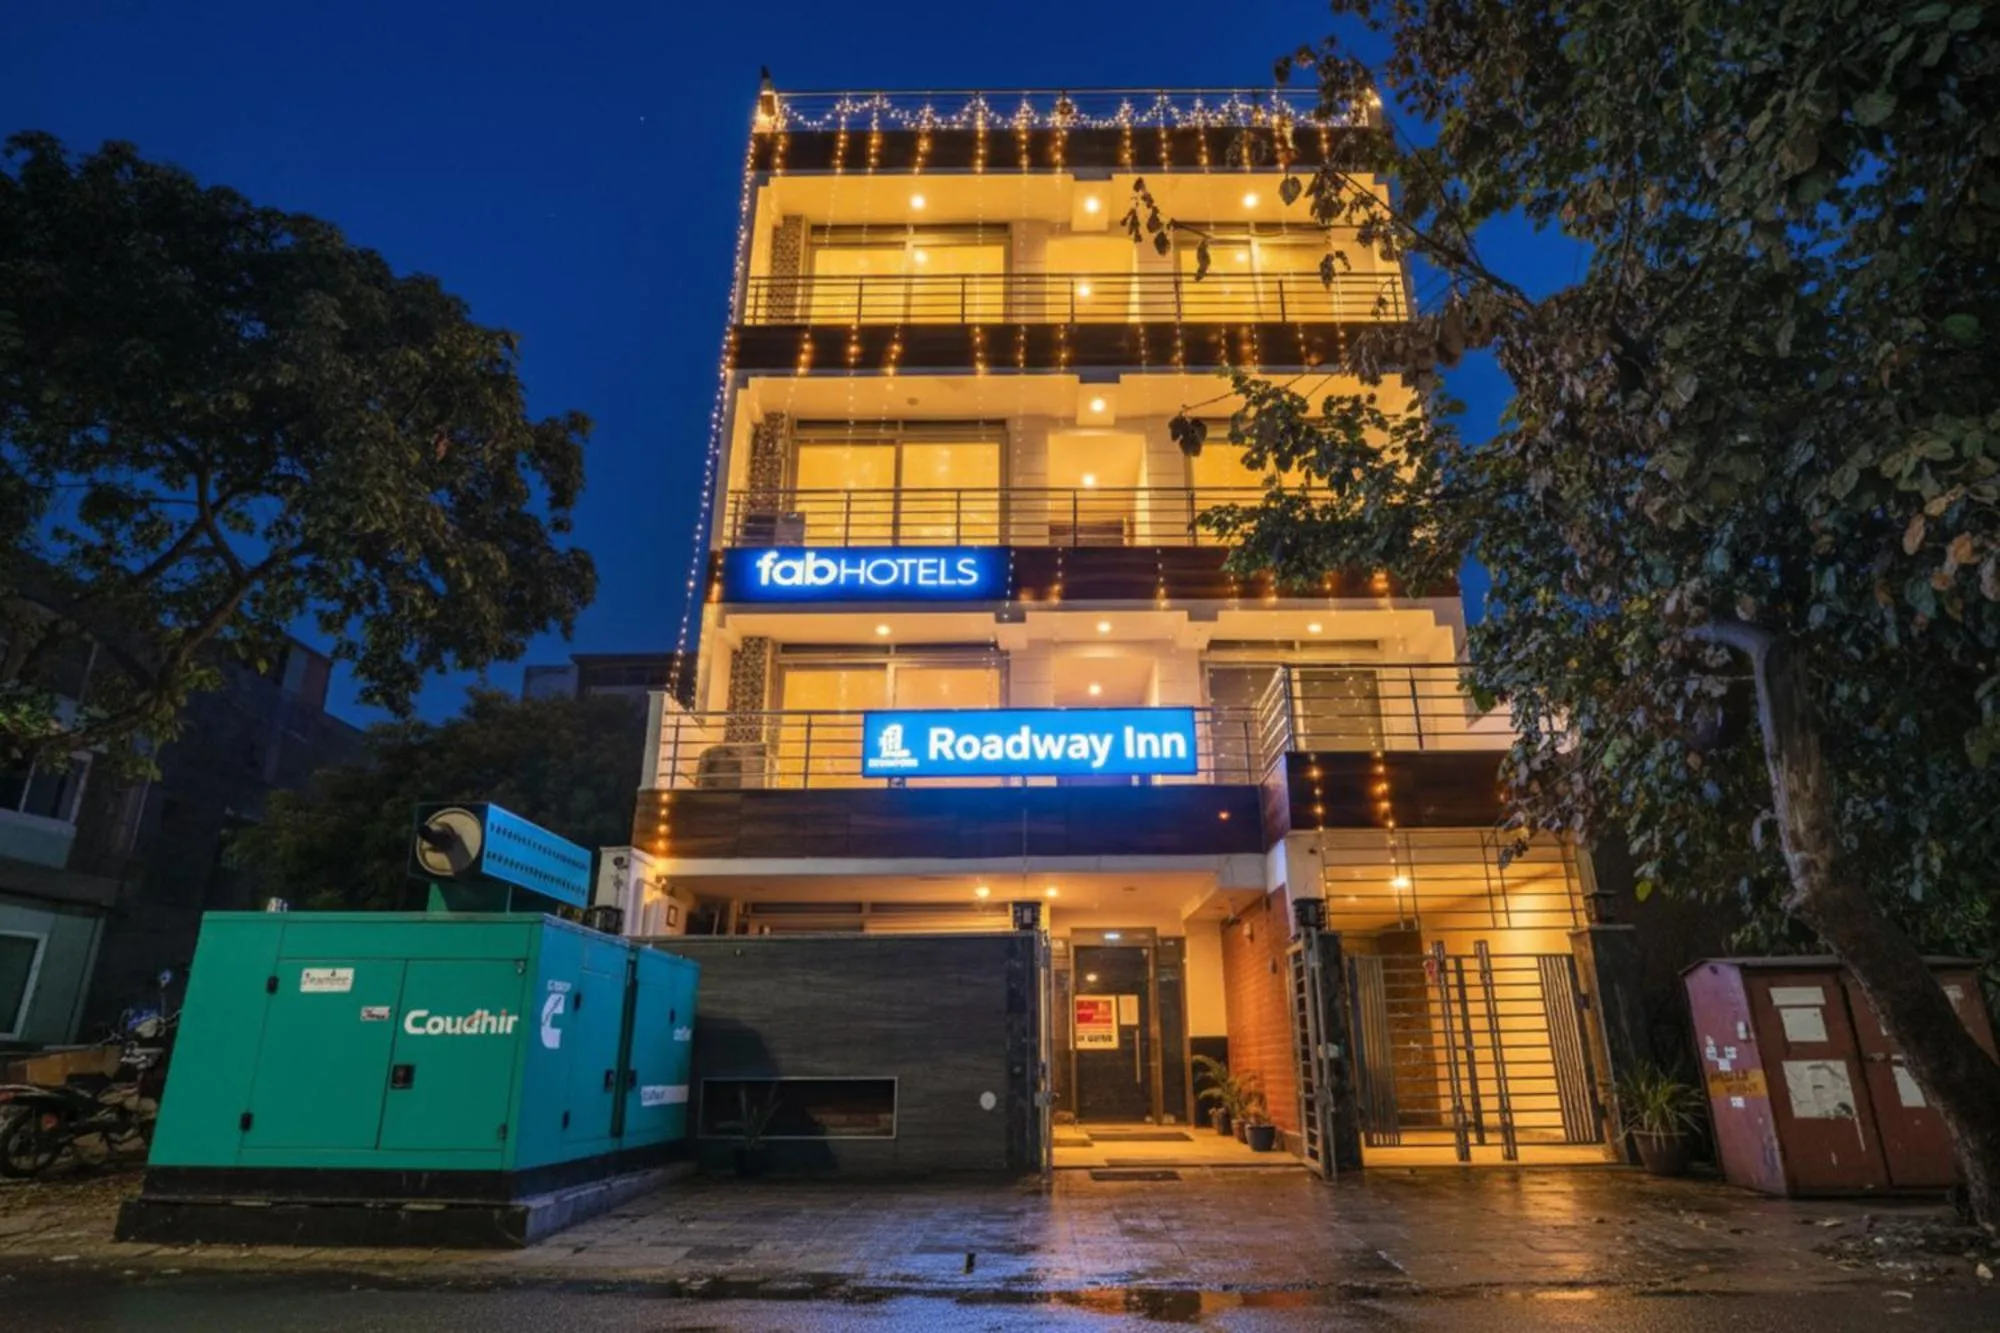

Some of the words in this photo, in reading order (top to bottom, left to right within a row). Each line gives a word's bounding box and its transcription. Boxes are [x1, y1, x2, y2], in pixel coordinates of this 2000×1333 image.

[756, 551, 979, 586] fabHOTELS
[928, 726, 1113, 769] Roadway
[1124, 726, 1187, 759] Inn
